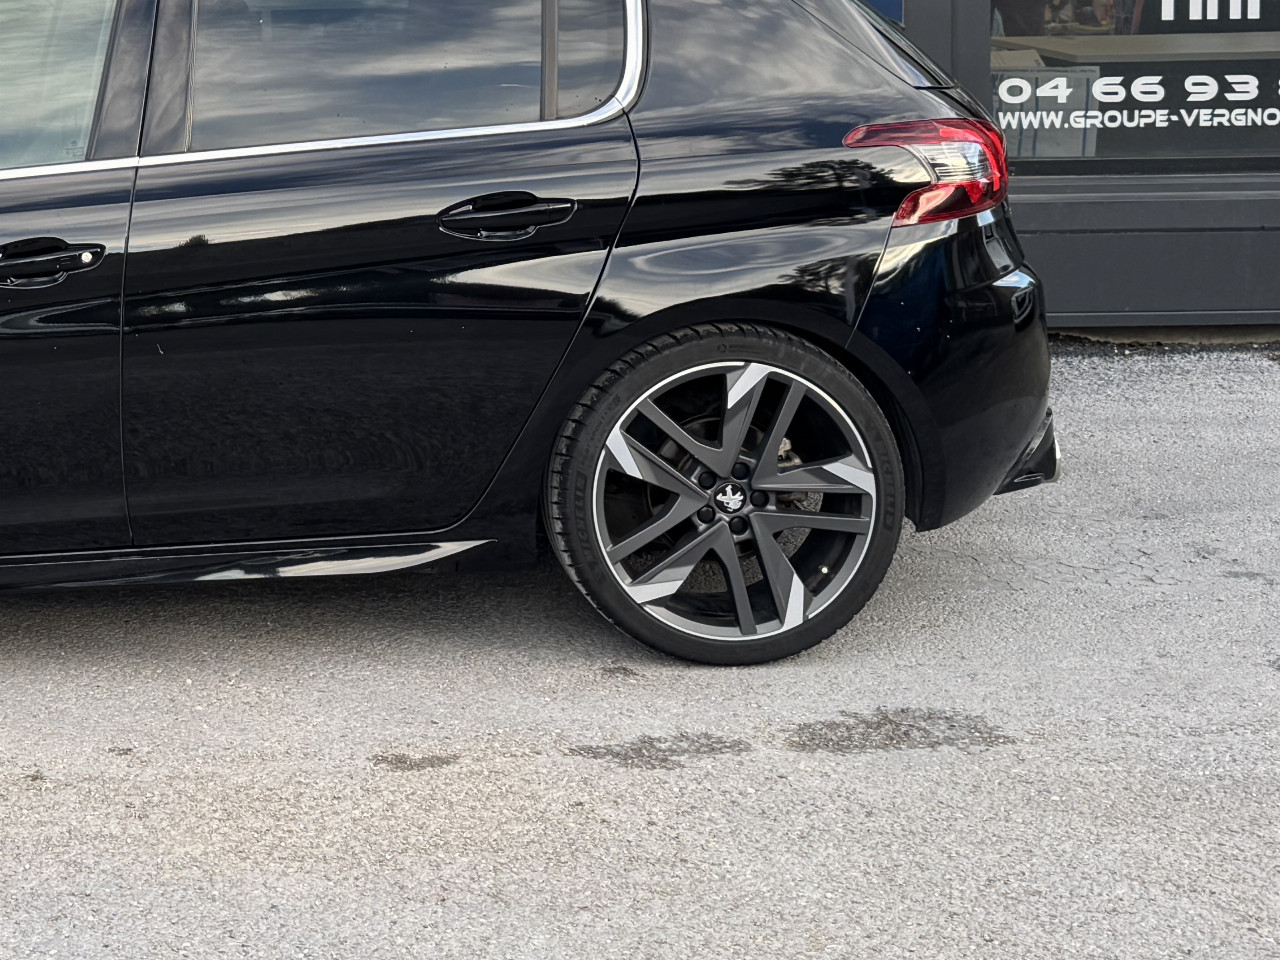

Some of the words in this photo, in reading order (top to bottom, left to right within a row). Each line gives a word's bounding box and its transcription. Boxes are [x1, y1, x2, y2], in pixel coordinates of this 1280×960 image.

[998, 77, 1073, 104] 04
[1091, 76, 1165, 103] 66
[1184, 75, 1259, 102] 93
